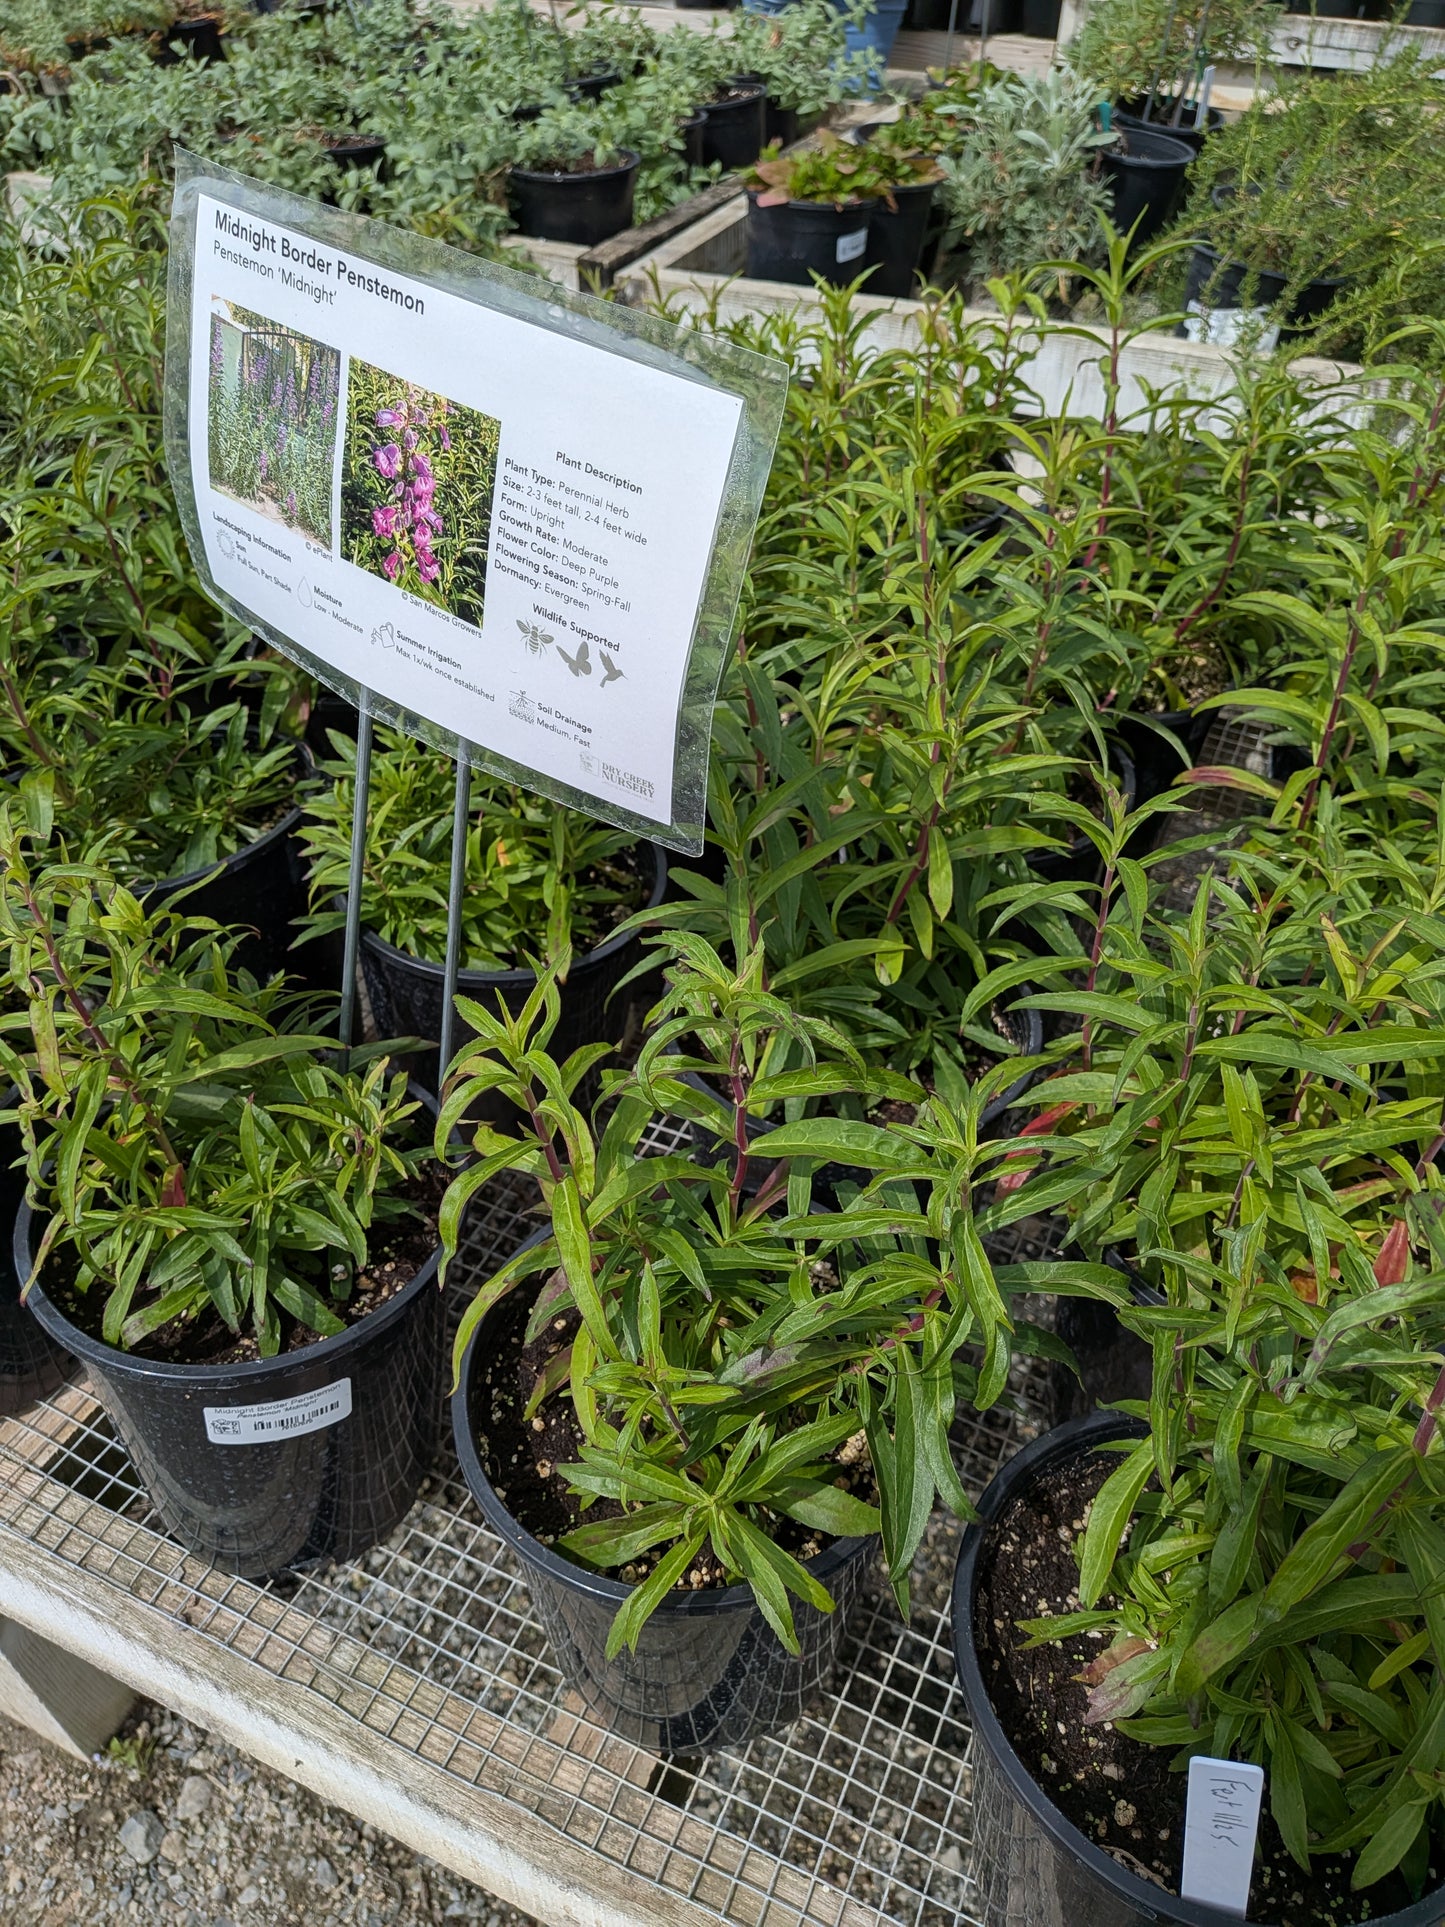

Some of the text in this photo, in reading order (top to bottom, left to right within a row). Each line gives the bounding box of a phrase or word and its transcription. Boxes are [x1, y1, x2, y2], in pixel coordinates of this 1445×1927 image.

[213, 240, 337, 305] Penstemon 'Midnight'
[215, 210, 425, 315] Midnight Border Penstemon
[504, 458, 630, 519] Plant Type: Perennial Herb
[556, 451, 643, 495] Plant Description
[500, 492, 566, 530] Form: Upright
[502, 475, 648, 546] Size: 2-3 feet tall, 2-4 feet wide
[212, 511, 293, 563] Landscaping Information
[235, 540, 247, 554] Sun
[313, 546, 334, 563] ePlant
[497, 526, 619, 590] Flower Color: Deep Purple
[499, 509, 609, 567] Growth Rate: Moderate
[236, 554, 293, 594] Full Sun, Part Shade
[494, 558, 590, 611] Dormancy: Evergreen
[495, 542, 631, 613] Flowering Season: Spring-Fall
[313, 585, 343, 608] Moisture
[314, 600, 327, 615] Low
[332, 612, 364, 634] Moderate
[409, 595, 423, 609] San
[424, 602, 450, 623] Marcos
[451, 617, 483, 639] Growers
[532, 602, 621, 652] Wildlife Supported
[396, 630, 462, 670] Summer Irrigation
[395, 645, 496, 702] Max 1x/wk once established
[536, 717, 591, 749] Medium, Fast
[537, 702, 593, 734] Soil Drainage
[602, 762, 655, 790] DRY CREEK
[602, 770, 655, 798] NURSERY
[215, 1384, 341, 1415] Midnight Border Penstemon
